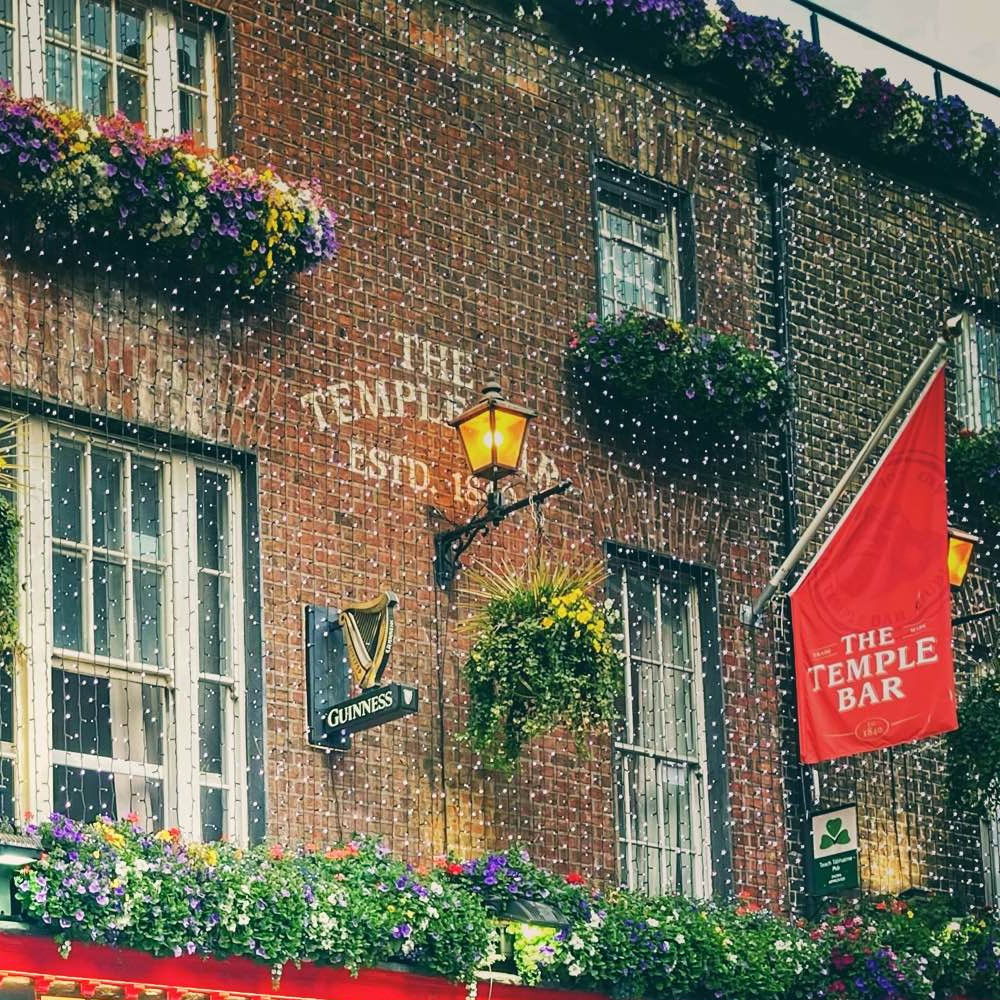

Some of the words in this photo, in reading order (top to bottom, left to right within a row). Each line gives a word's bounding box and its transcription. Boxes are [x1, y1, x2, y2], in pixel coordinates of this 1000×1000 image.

[396, 332, 475, 389] THE
[300, 379, 469, 430] TEMPLE
[841, 626, 895, 655] THE
[808, 636, 939, 692] TEMPLE
[327, 690, 393, 727] GUINNESS
[837, 676, 906, 712] BAR
